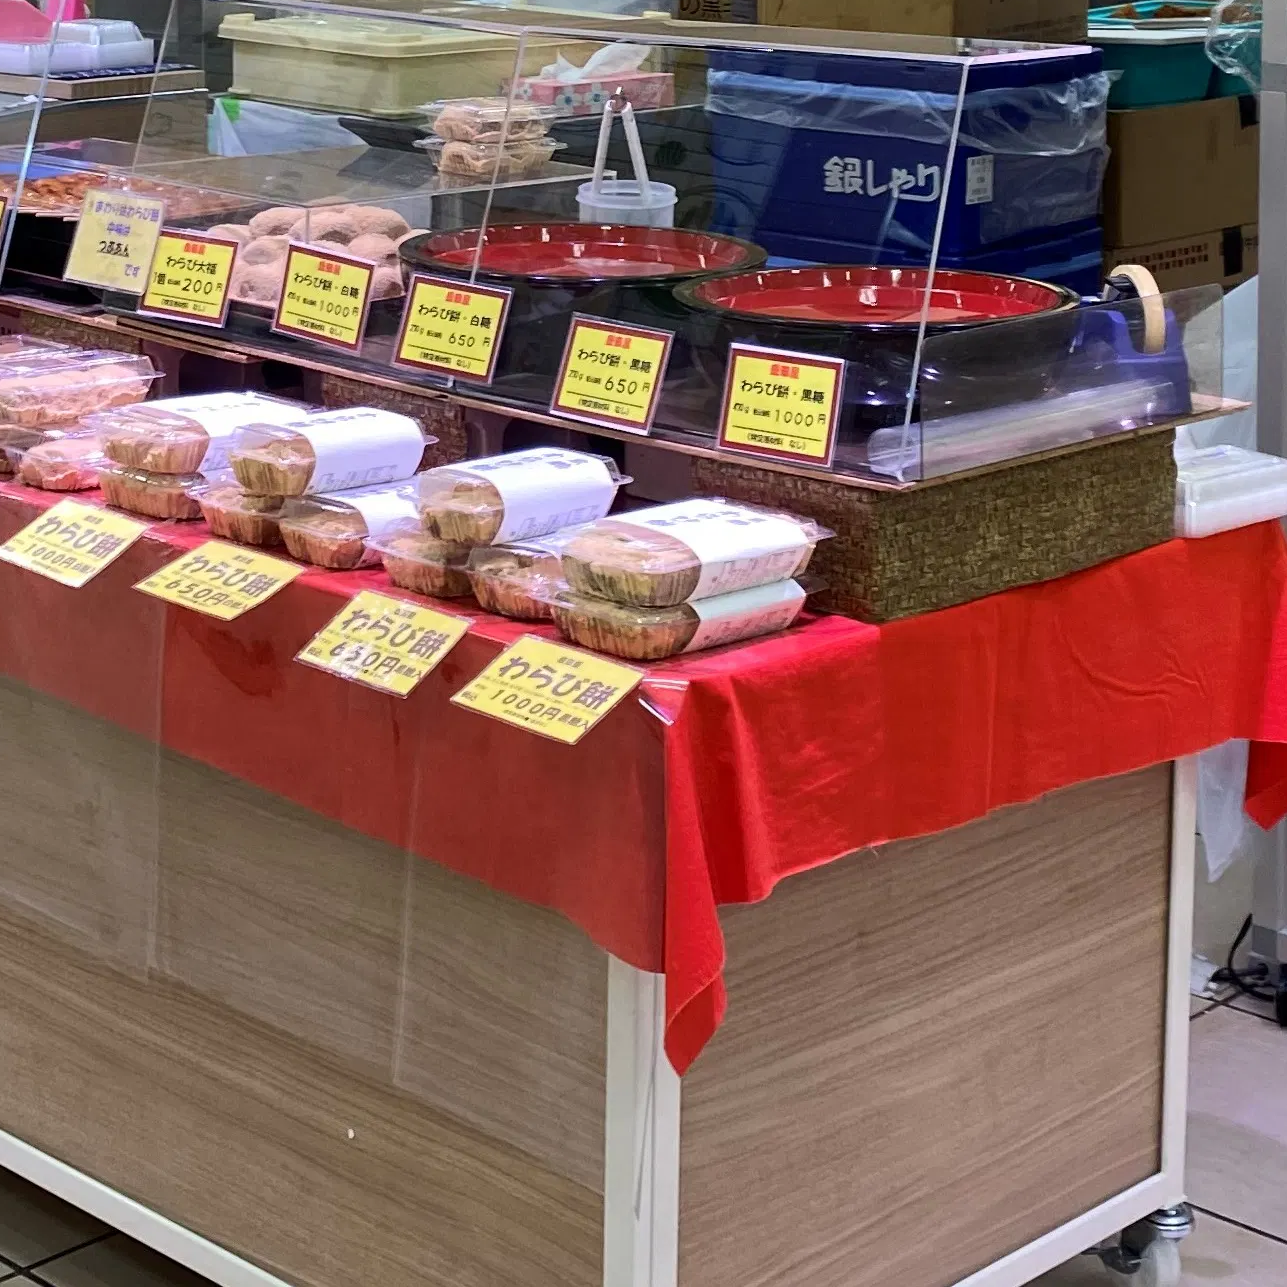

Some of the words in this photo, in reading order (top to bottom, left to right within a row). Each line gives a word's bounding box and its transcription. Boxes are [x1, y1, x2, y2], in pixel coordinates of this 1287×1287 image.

[823, 156, 941, 202] 銀しゃり
[166, 256, 218, 275] わらび大福
[35, 515, 127, 560] わらび餅
[180, 555, 280, 598] わらび餅
[341, 608, 451, 660] わらび餅
[498, 656, 620, 710] わらび餅
